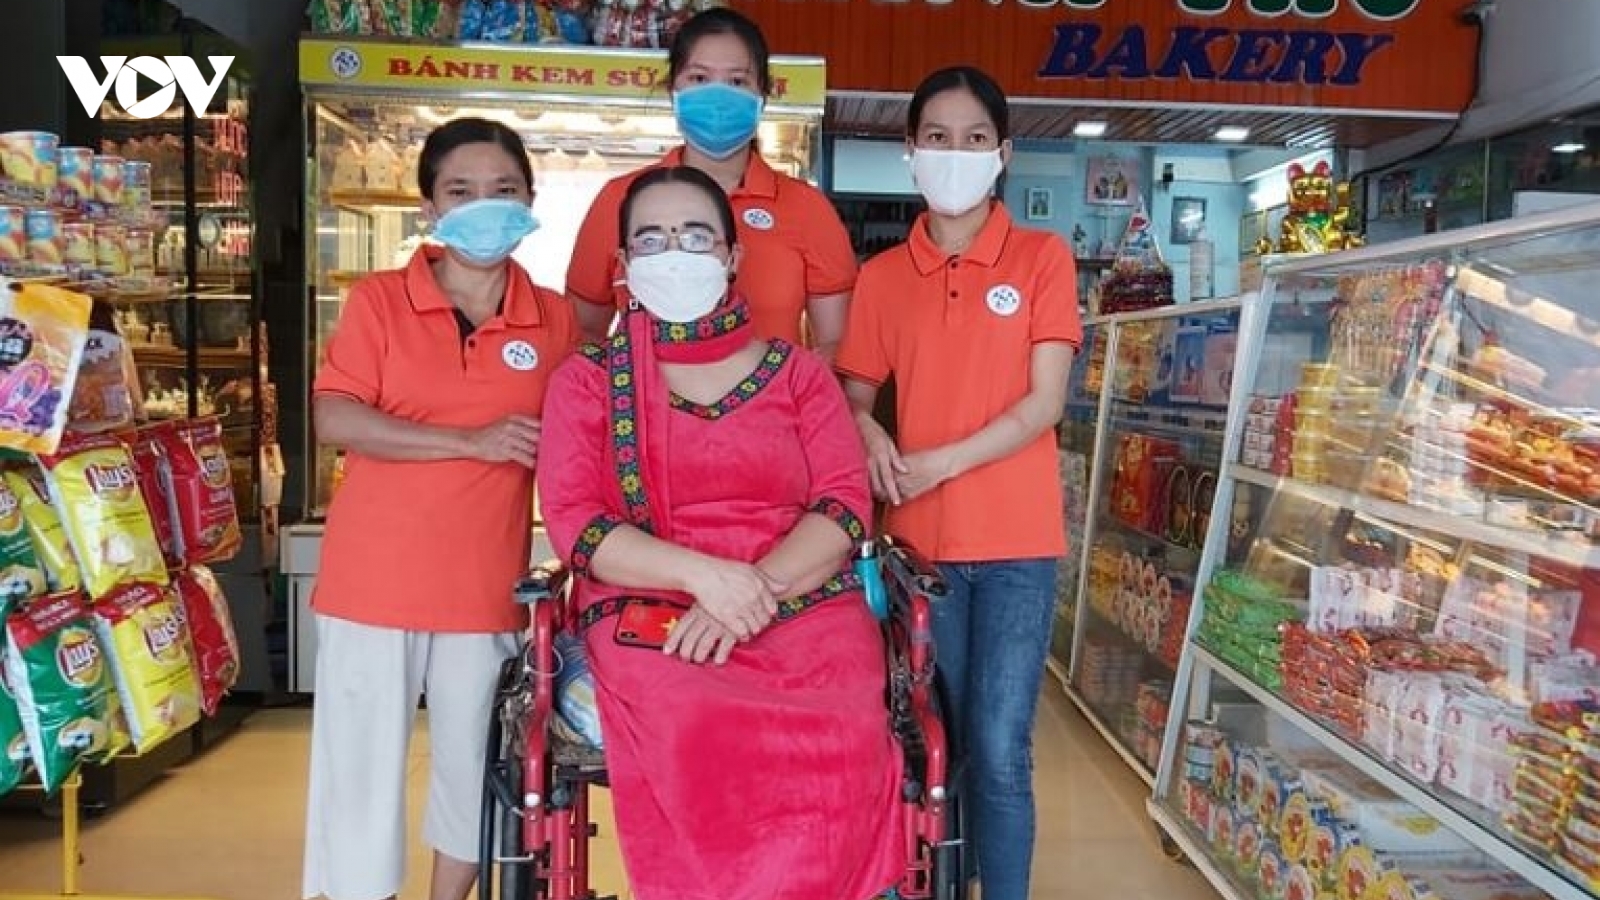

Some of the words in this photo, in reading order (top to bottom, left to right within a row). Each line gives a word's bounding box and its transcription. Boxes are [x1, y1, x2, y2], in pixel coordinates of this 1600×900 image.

[388, 56, 499, 80] BÁNH
[511, 65, 594, 86] KEM
[606, 66, 666, 88] SỮ
[1038, 22, 1395, 86] BAKERY
